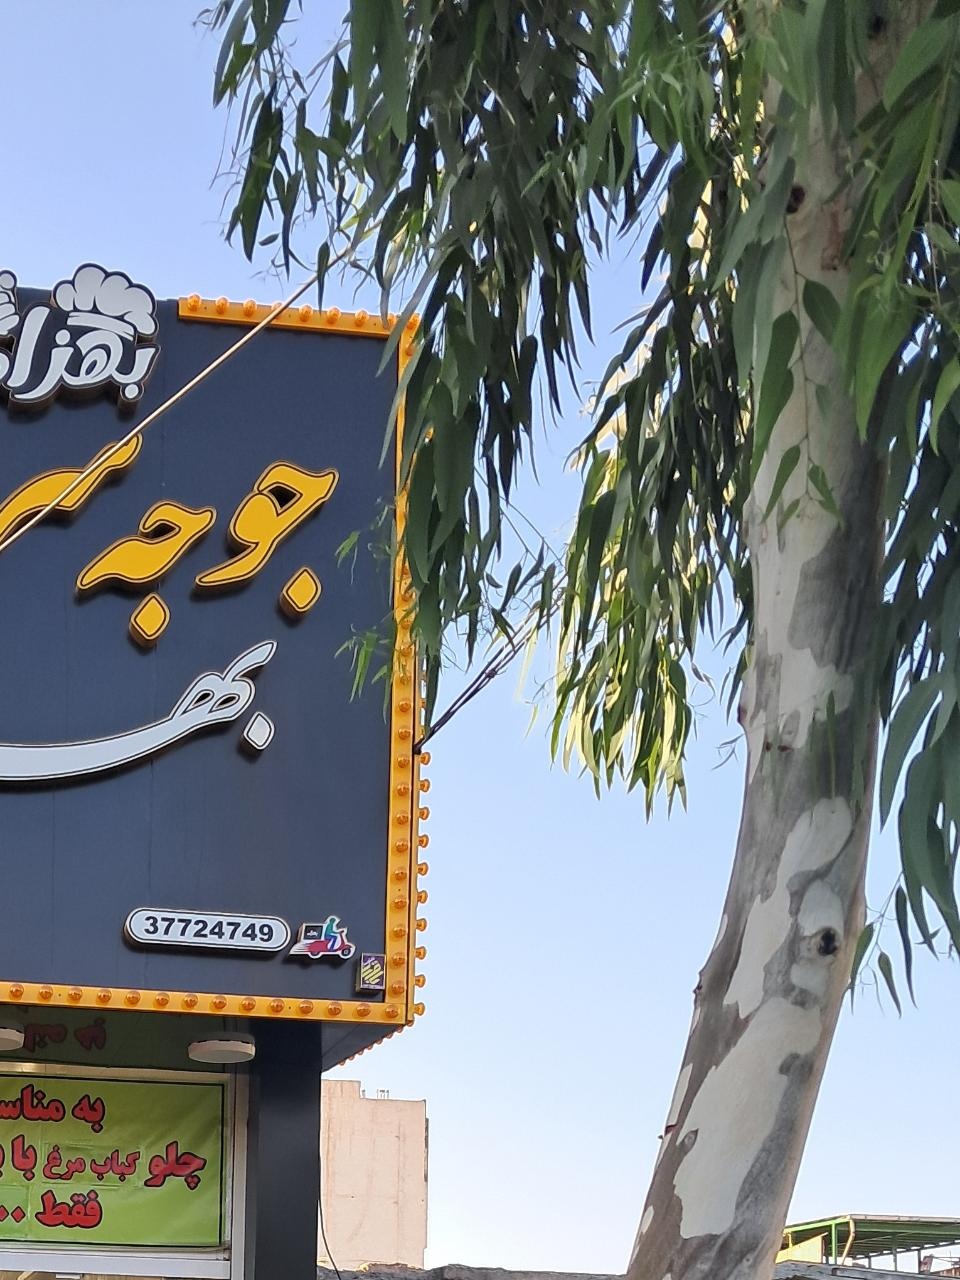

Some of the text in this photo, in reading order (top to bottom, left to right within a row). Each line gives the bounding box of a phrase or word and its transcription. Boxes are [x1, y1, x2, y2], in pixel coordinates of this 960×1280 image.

[76, 459, 340, 643] جوجه
[144, 915, 274, 943] 37724749
[71, 1093, 106, 1133] به
[11, 1134, 38, 1181] با
[43, 1145, 86, 1180] مرغ
[90, 1149, 140, 1181] کباب
[143, 1140, 208, 1190] چلو
[35, 1189, 103, 1229] فقط
